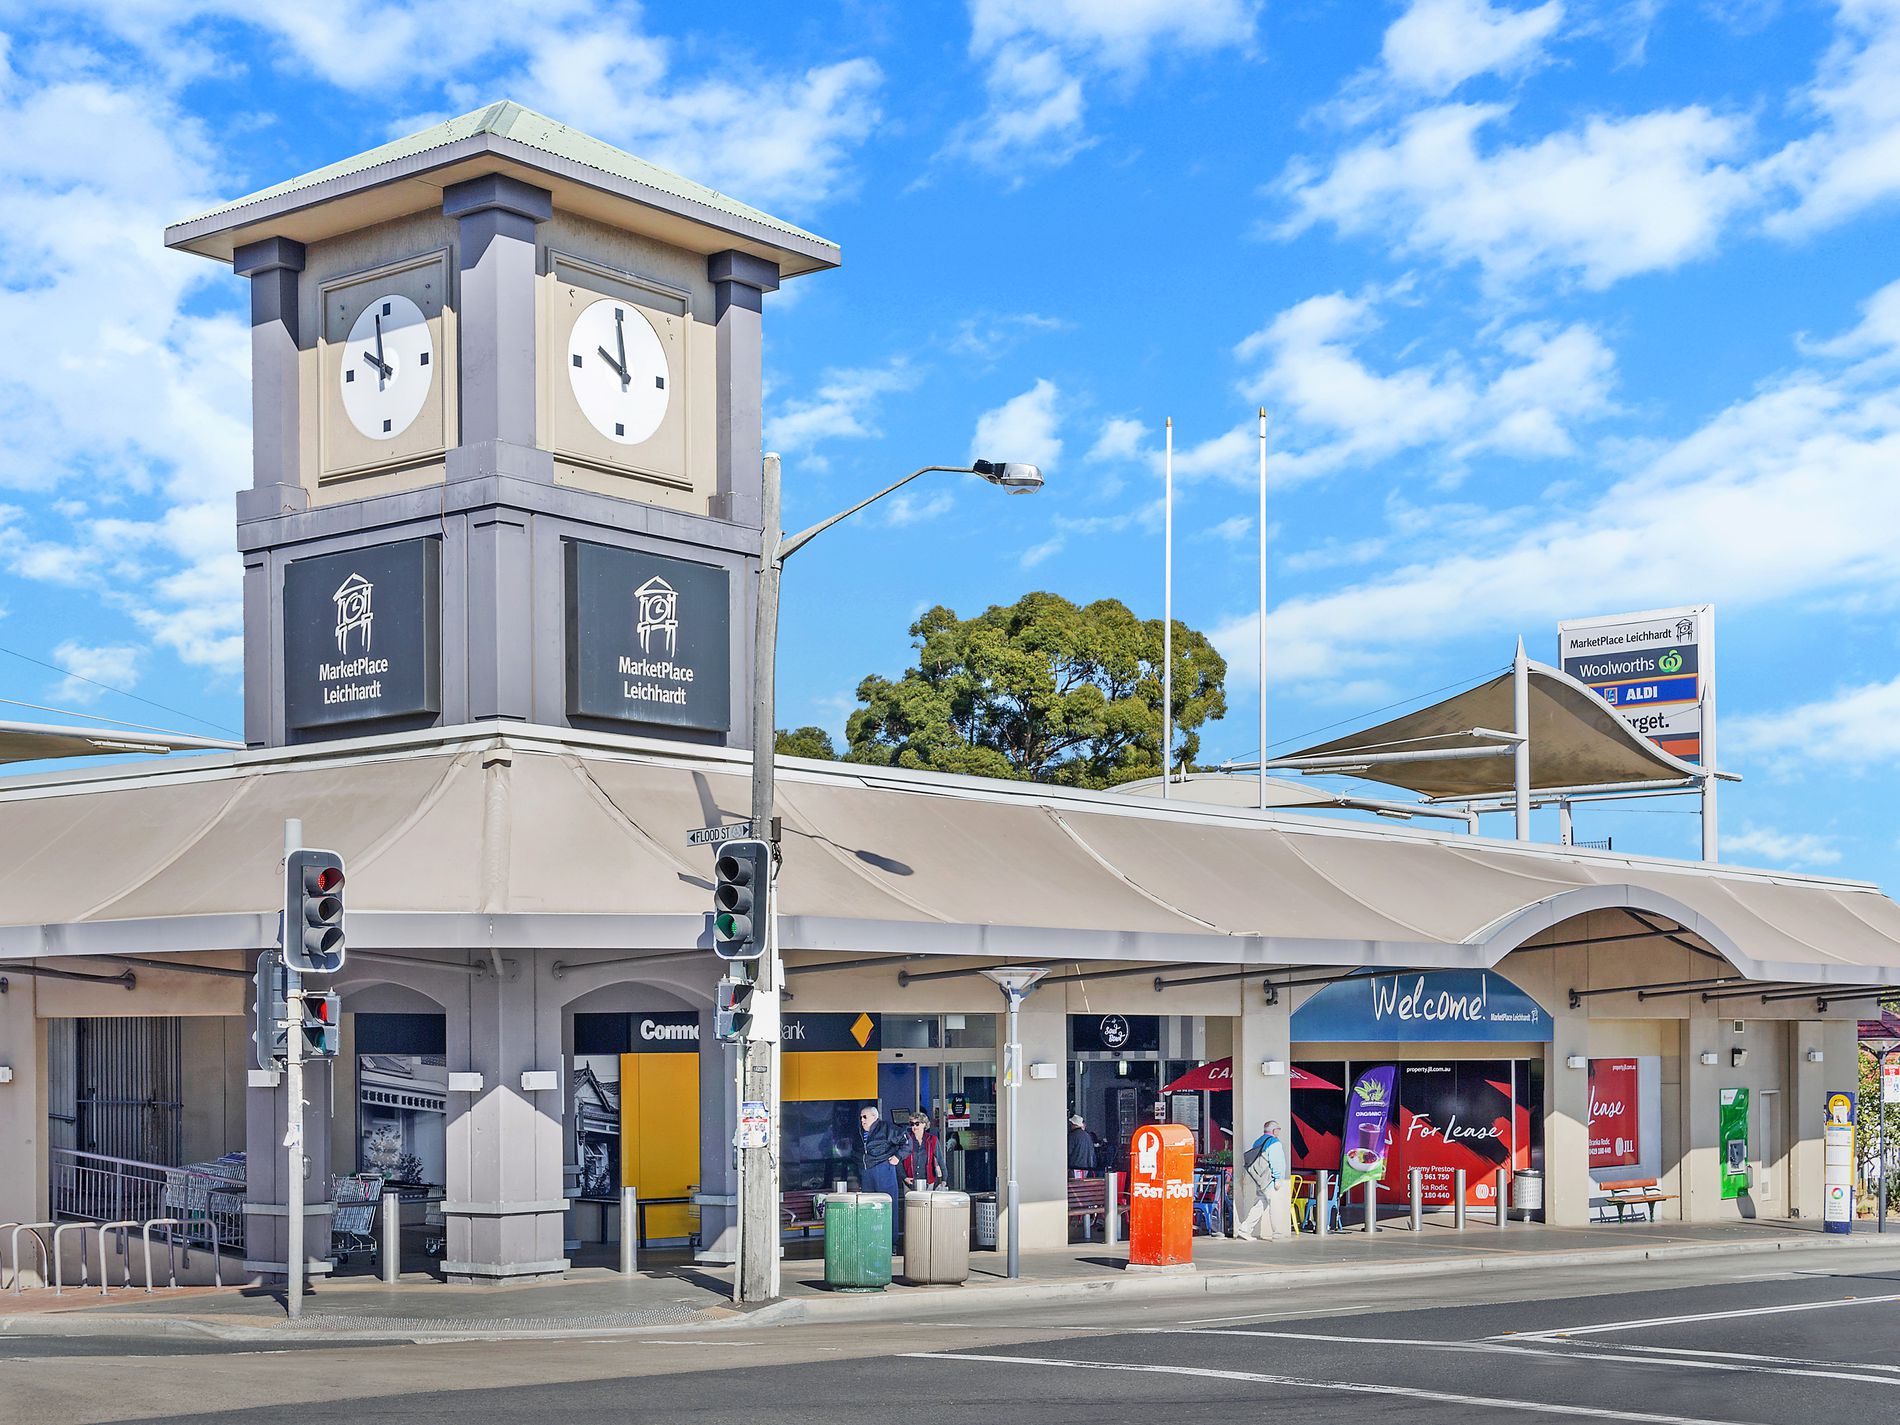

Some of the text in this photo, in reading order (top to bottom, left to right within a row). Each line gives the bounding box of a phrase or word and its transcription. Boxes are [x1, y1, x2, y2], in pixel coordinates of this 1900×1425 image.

[1570, 629, 1672, 649] MarketPlace Leichhardt
[320, 657, 388, 681] MarketPlace
[619, 656, 693, 682] MarketPlace
[1580, 657, 1654, 678] Woolworths
[324, 680, 381, 704] Leichhardt
[624, 681, 686, 704] Leichhardt
[1626, 686, 1658, 700] ALDI
[1622, 712, 1670, 733] rget.
[696, 827, 730, 842] FLOOD ST
[1371, 974, 1486, 1020] Welcome!
[1588, 1086, 1625, 1126] Lease
[1407, 1114, 1503, 1144] For Lease
[1624, 1140, 1634, 1152] JLL
[1134, 1186, 1163, 1198] POST
[1166, 1184, 1194, 1199] POST
